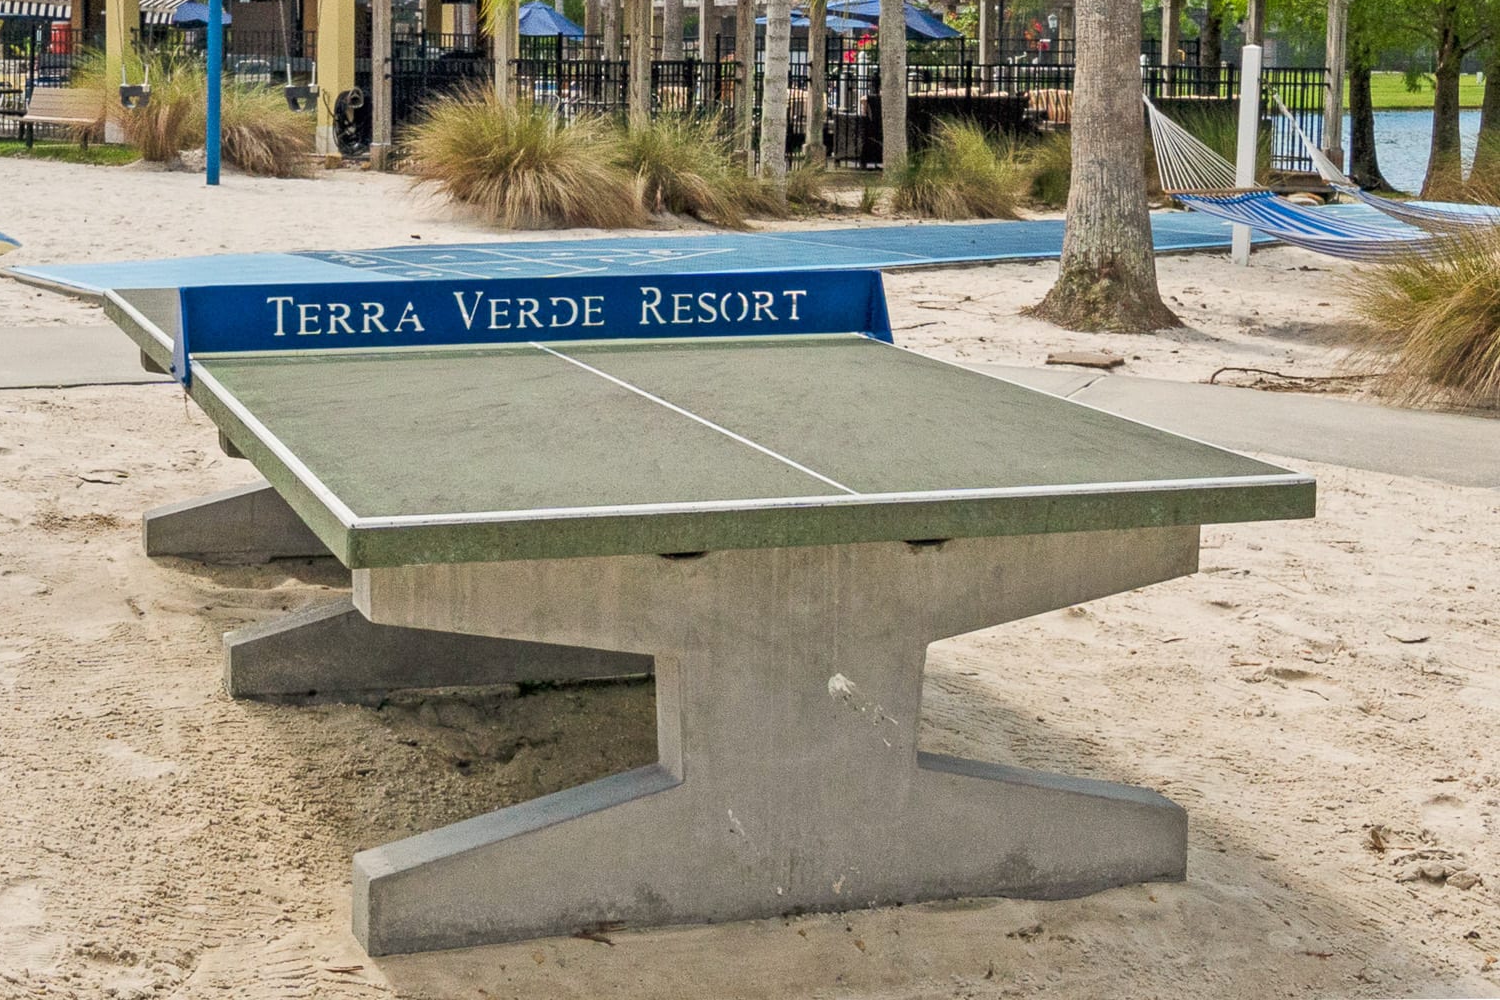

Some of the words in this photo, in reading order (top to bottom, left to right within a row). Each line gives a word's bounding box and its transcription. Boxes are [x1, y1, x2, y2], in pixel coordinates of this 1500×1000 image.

[267, 296, 424, 335] TERRA
[454, 290, 604, 329] VERDE
[640, 286, 806, 324] RESORT
